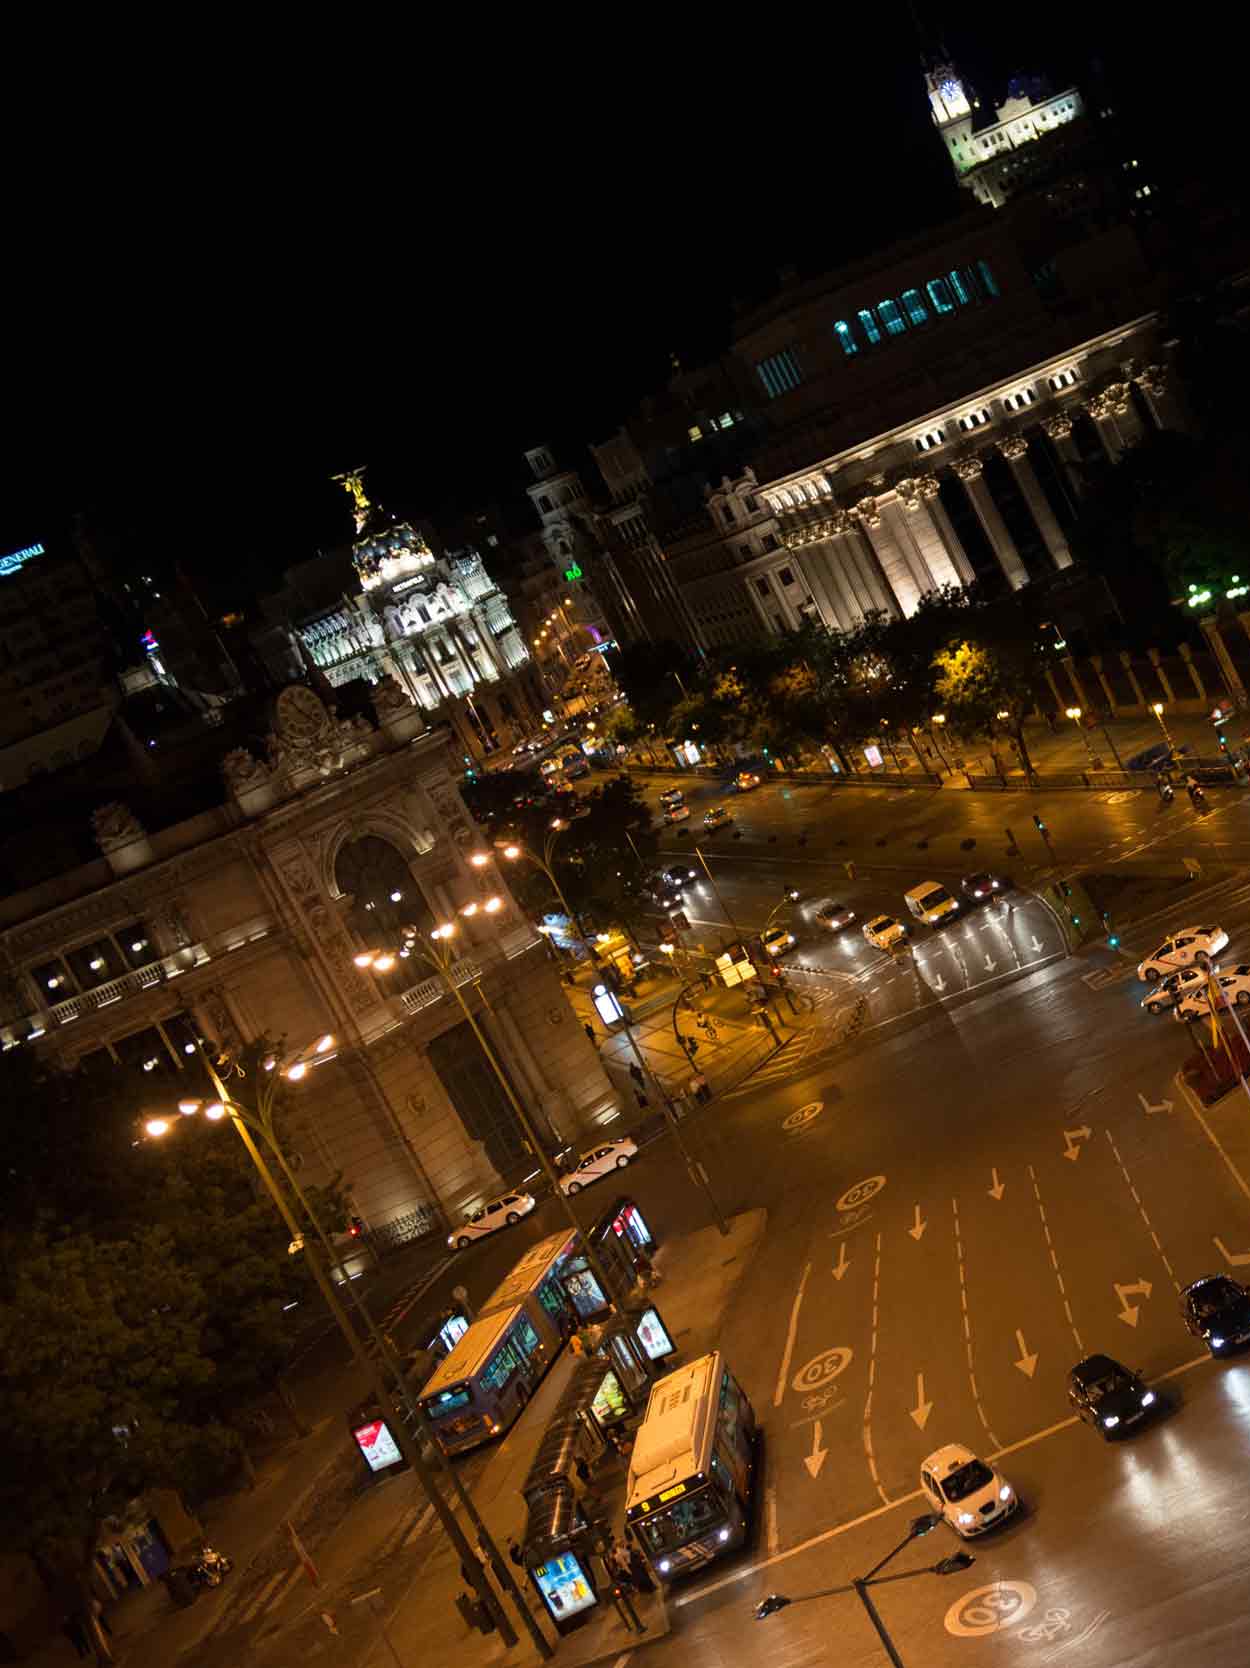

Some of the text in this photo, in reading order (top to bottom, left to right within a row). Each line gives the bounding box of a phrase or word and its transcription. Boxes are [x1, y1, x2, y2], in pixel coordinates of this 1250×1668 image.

[848, 1183, 876, 1202] 30
[807, 1355, 840, 1381] 30
[963, 1592, 1019, 1625] 30
